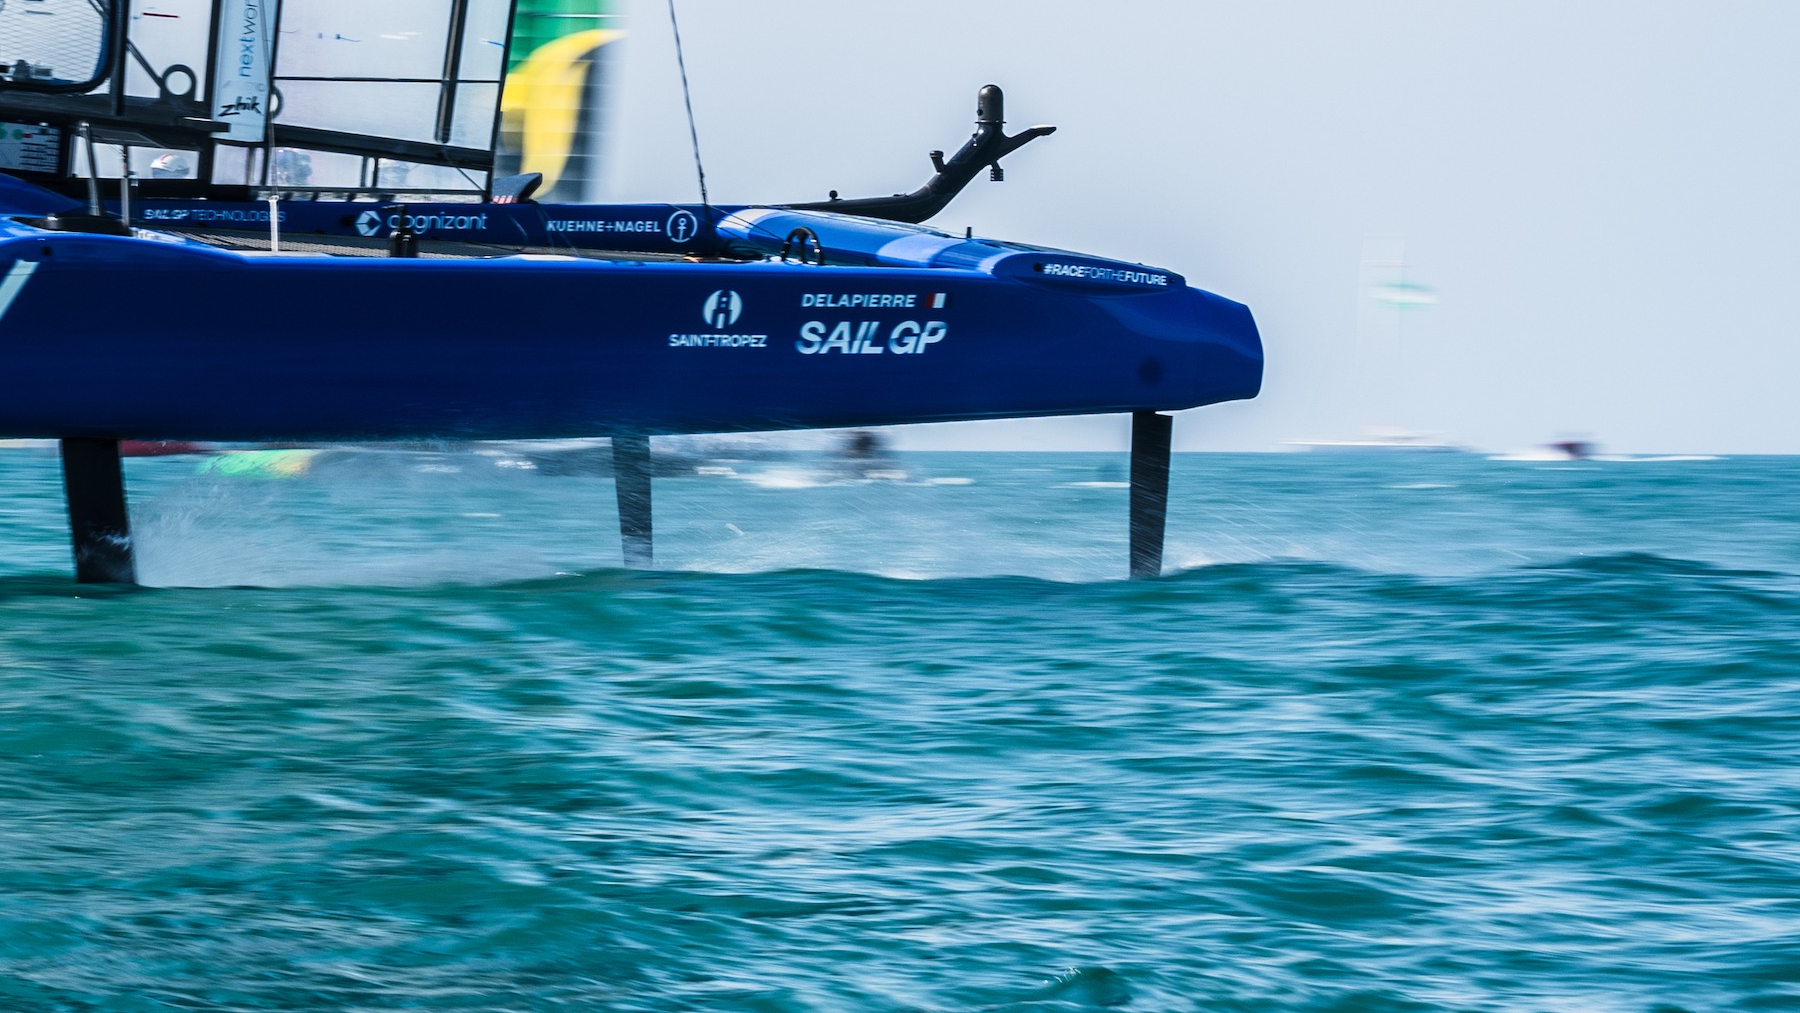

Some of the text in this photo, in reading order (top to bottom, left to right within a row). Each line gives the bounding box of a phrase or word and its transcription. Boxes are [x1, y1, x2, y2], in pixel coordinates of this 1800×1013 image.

[387, 211, 488, 235] cognizant
[546, 220, 662, 233] KUEHNE+NAGEL
[1043, 263, 1168, 286] #RACEFORTHEFUTURE
[801, 293, 918, 308] DELAPIERRE
[668, 333, 768, 348] SAINT-TROPEZ
